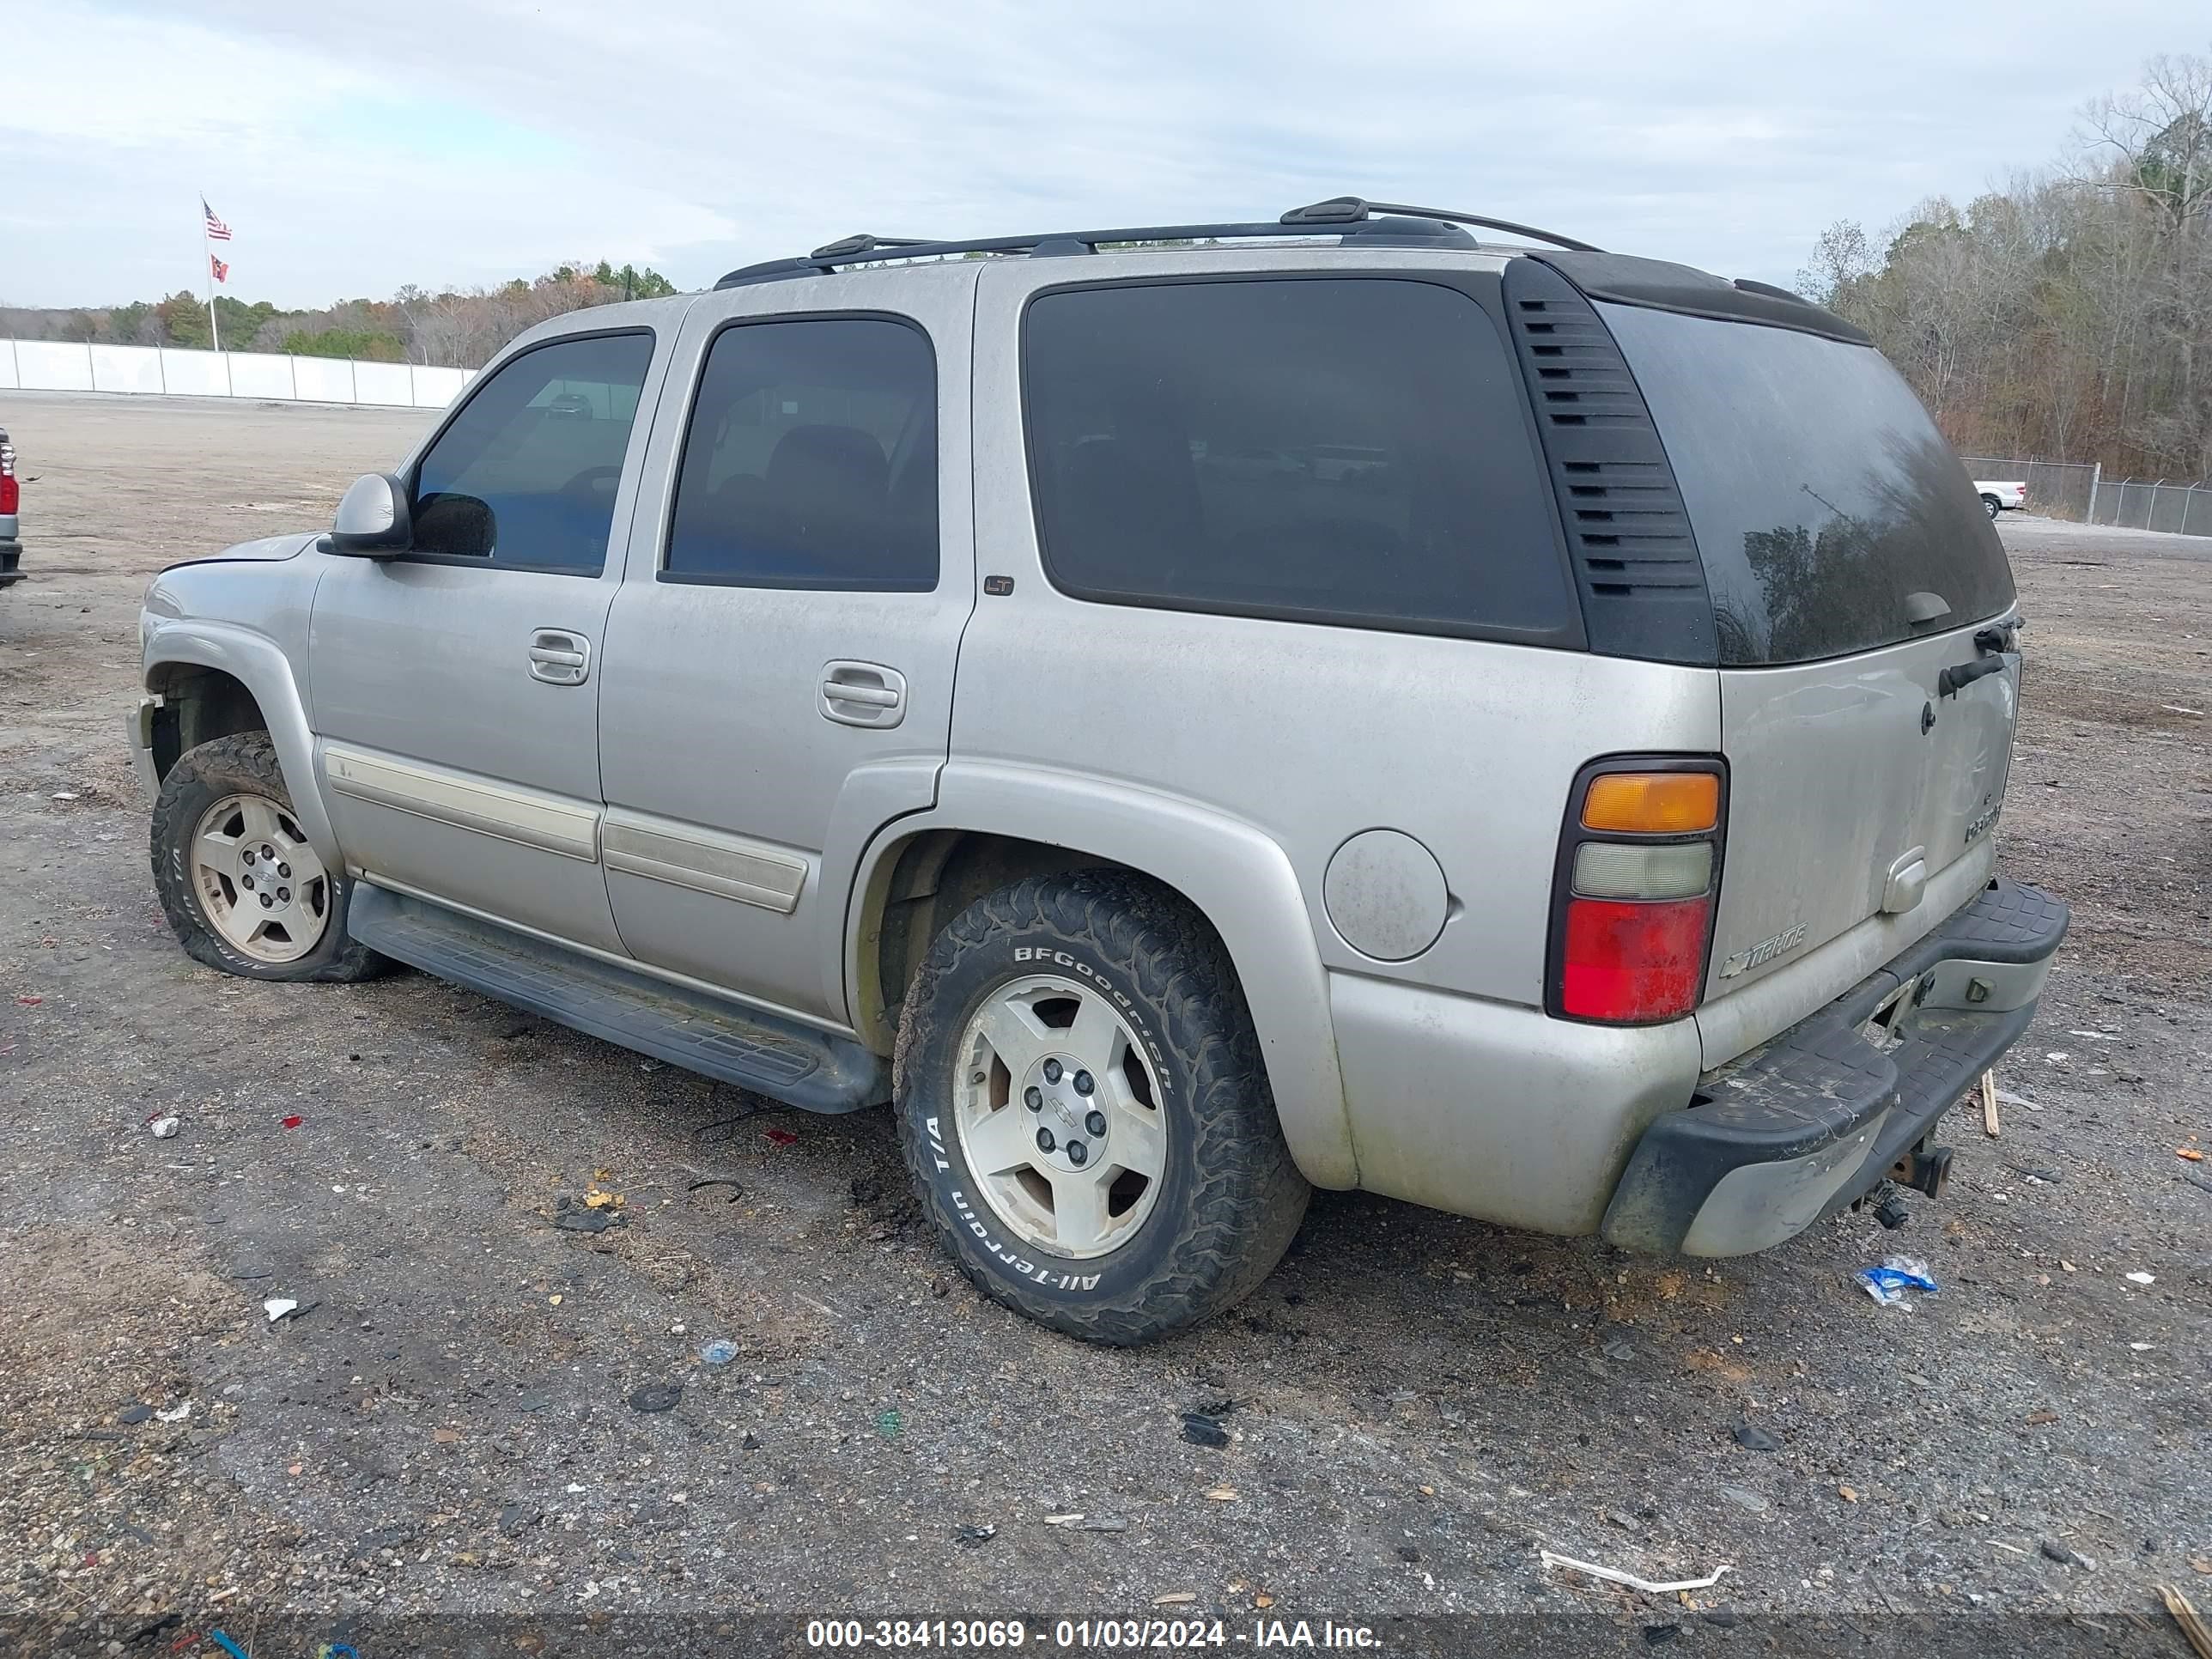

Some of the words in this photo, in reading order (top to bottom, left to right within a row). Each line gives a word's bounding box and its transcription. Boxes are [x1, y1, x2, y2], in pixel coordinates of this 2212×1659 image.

[986, 579, 1012, 592] LT
[1750, 921, 1808, 969] TAHOE
[1014, 947, 1174, 1091] BFGoodrich
[926, 1116, 951, 1175] T/A
[951, 1191, 1103, 1291] All-Terrain
